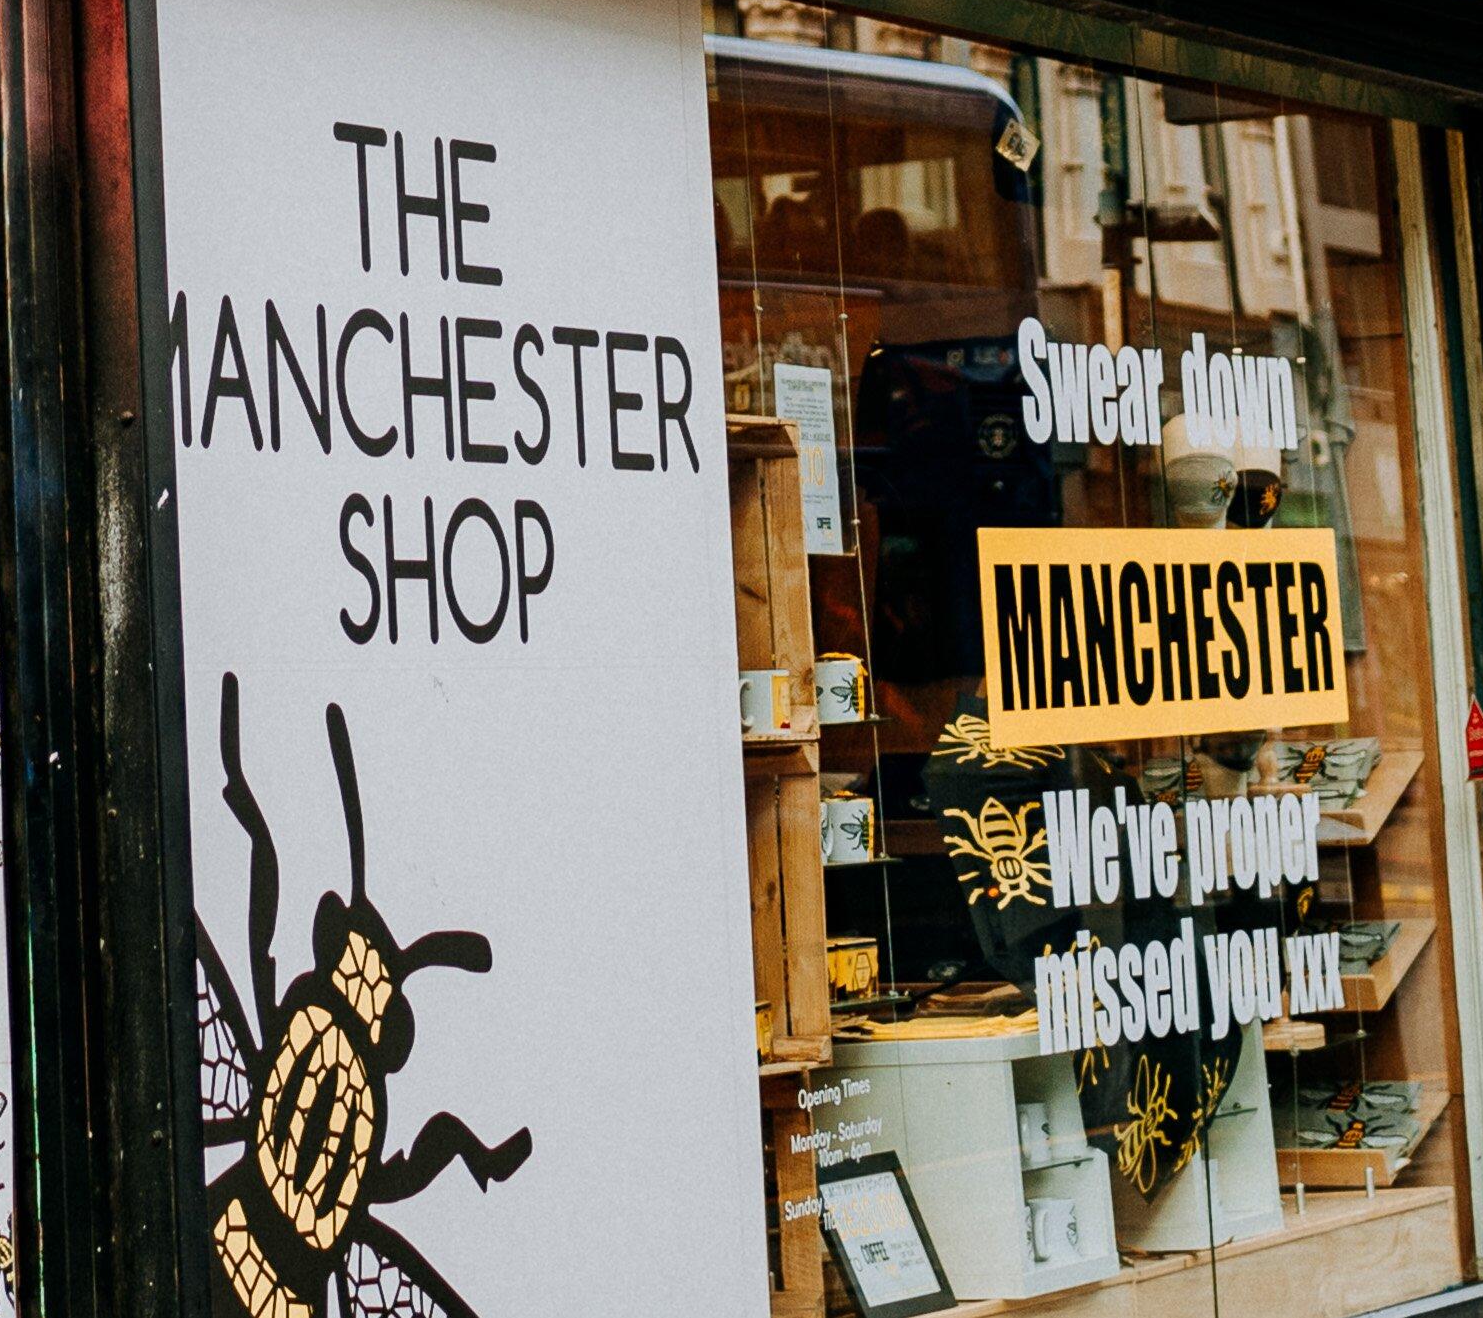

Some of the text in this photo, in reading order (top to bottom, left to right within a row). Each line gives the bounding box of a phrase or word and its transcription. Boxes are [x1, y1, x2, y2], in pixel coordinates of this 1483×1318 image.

[332, 121, 504, 286] THE
[1017, 316, 1299, 450] Swear down
[339, 492, 556, 646] SHOP
[993, 560, 1336, 713] MANCHESTER
[1042, 785, 1320, 909] We've proper
[1034, 916, 1346, 1057] missed you xxx
[790, 1117, 883, 1154] Monday Saturday
[798, 1078, 871, 1111] Opening Times
[784, 1196, 824, 1221] Sunday
[860, 1240, 890, 1265] COFFEE
